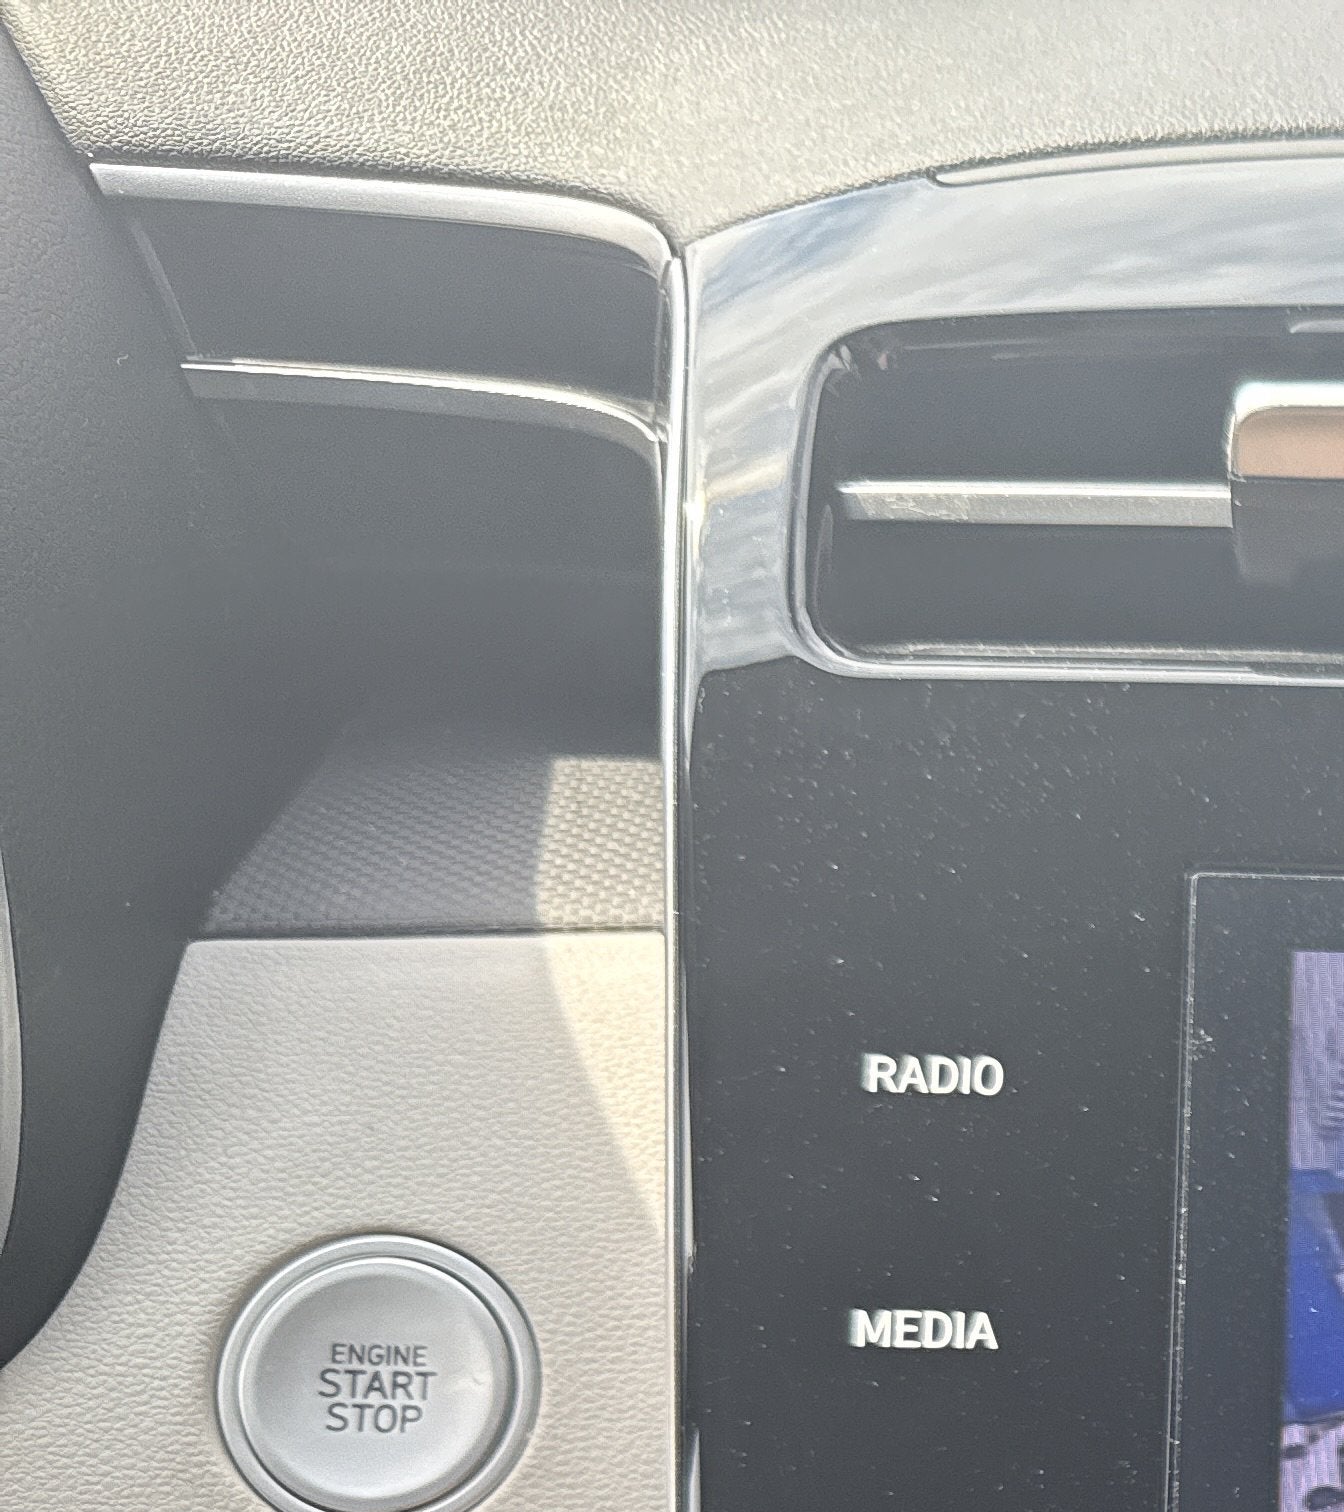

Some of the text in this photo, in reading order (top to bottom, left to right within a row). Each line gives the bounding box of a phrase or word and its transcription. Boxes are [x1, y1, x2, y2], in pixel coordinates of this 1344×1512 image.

[862, 1053, 1004, 1097] RADIO
[850, 1308, 999, 1350] MEDIA
[330, 1342, 428, 1367] ENGINE
[317, 1367, 438, 1401] START
[325, 1401, 424, 1434] STOP
